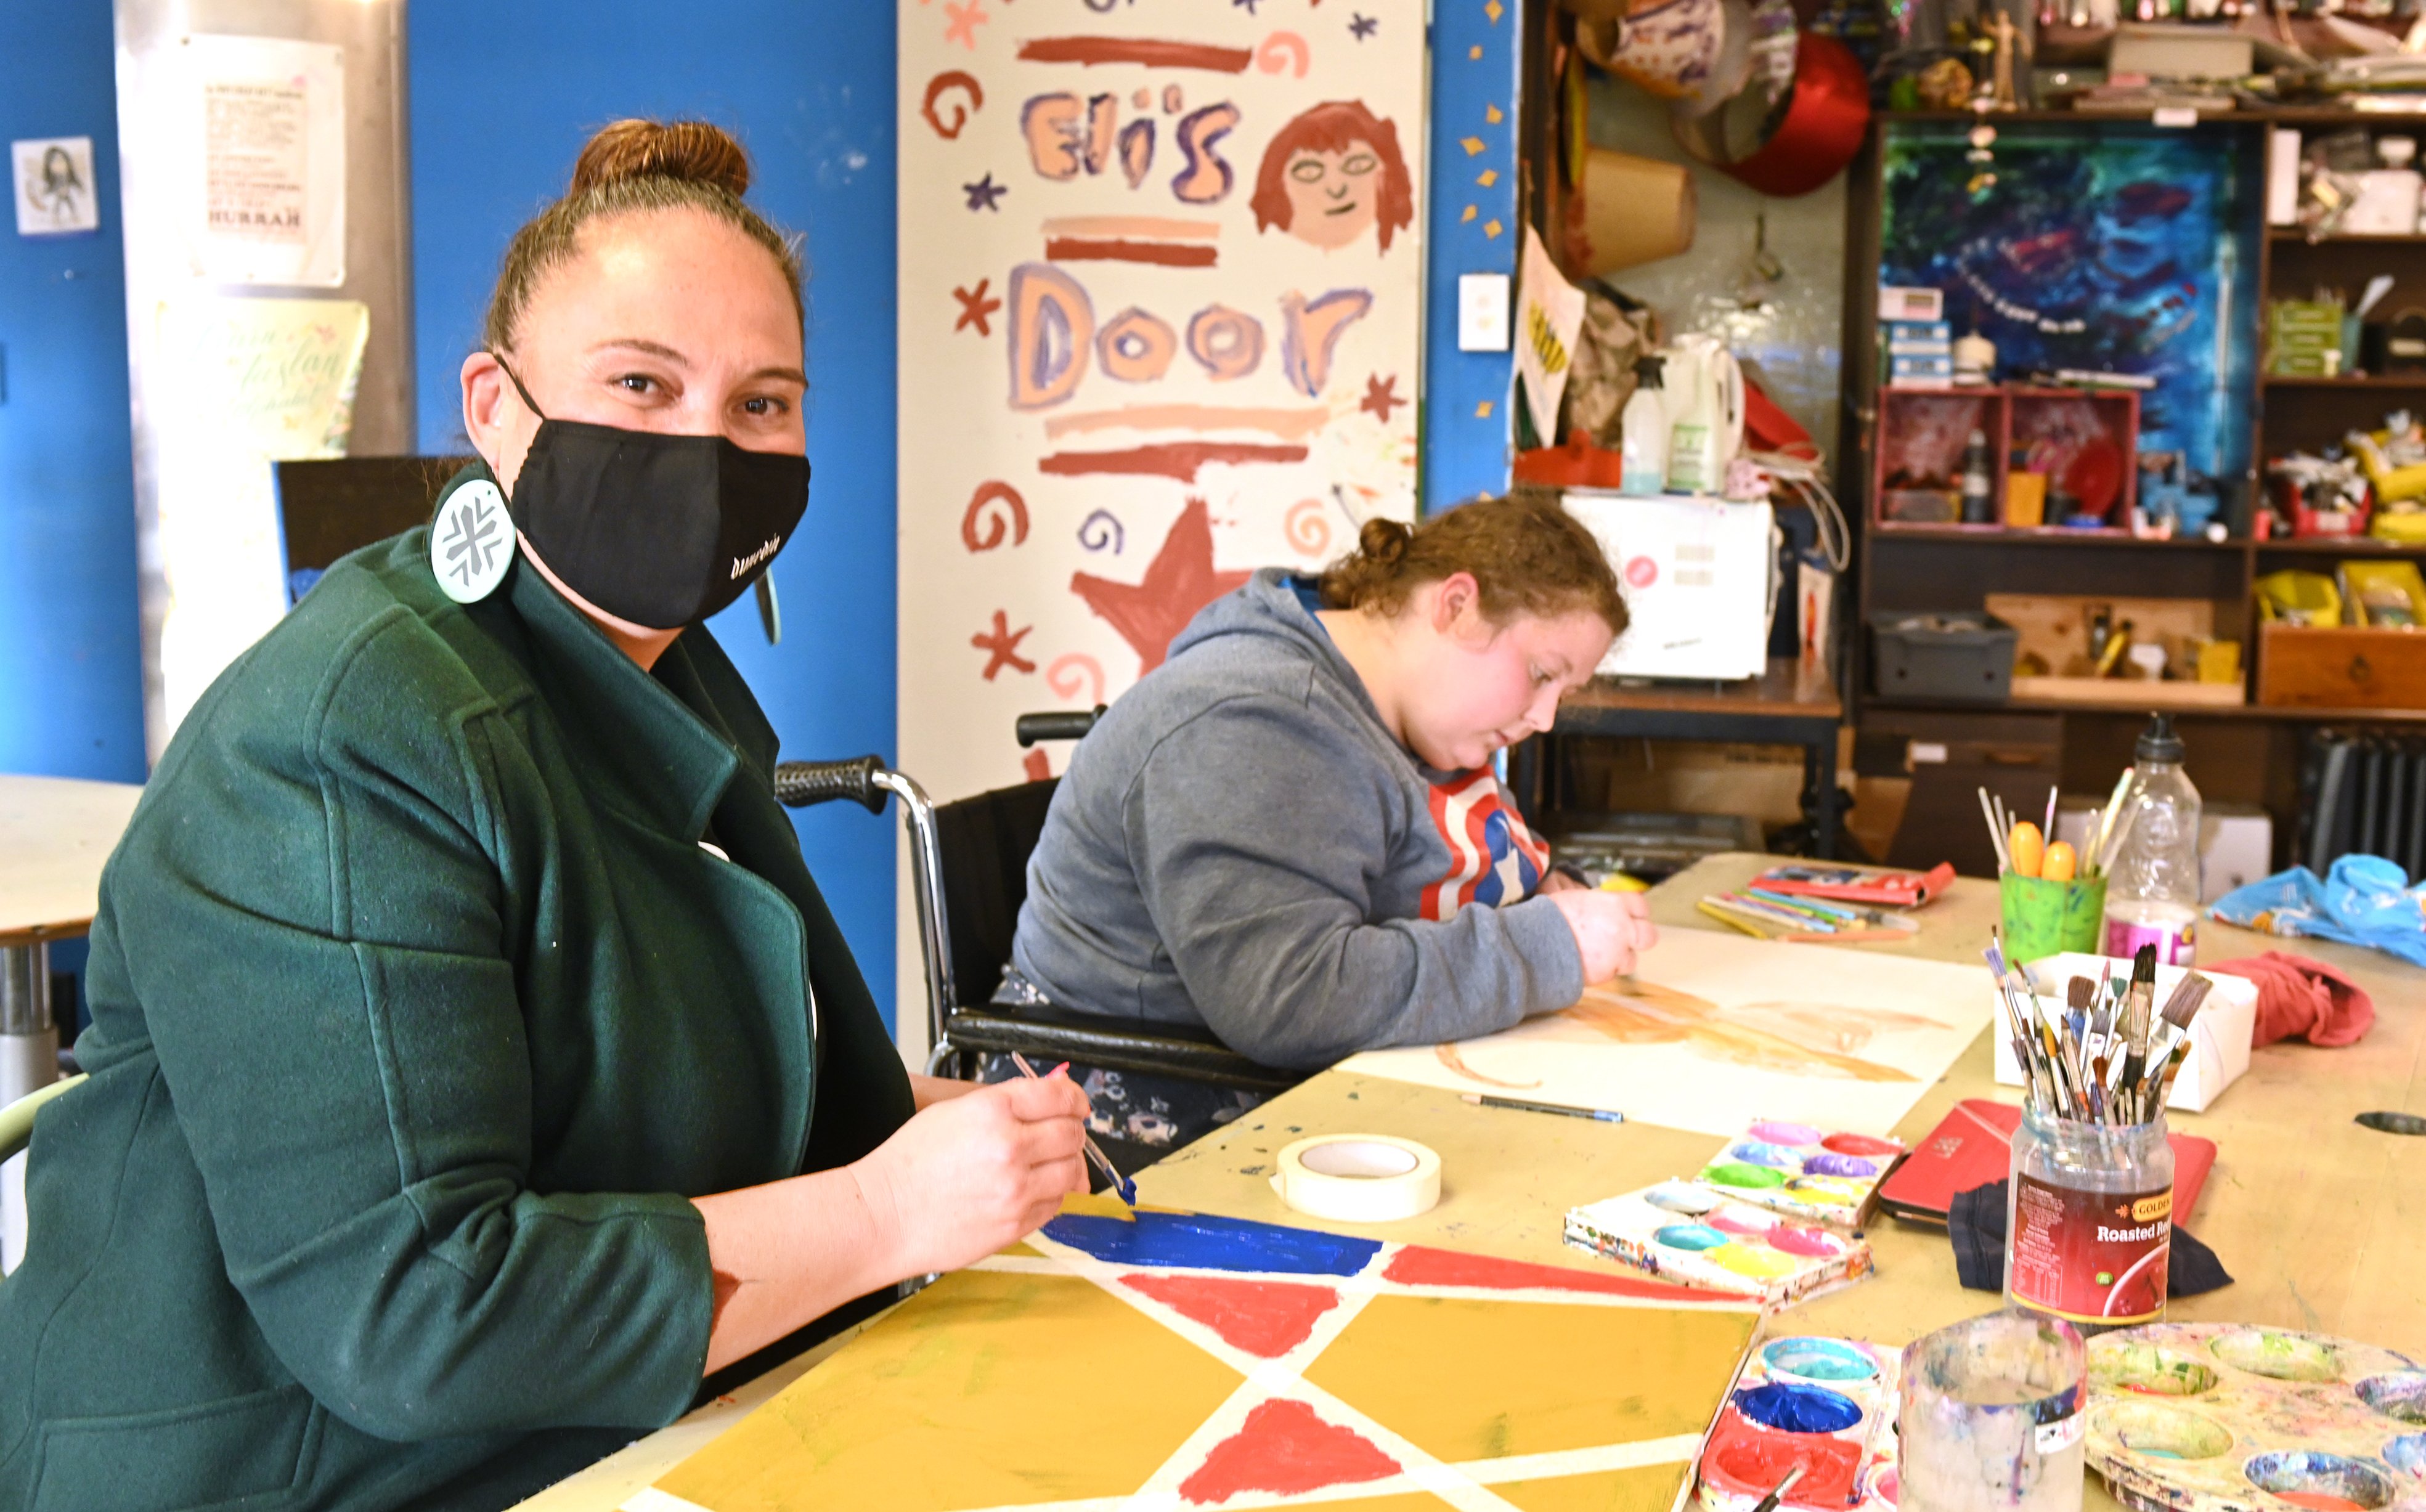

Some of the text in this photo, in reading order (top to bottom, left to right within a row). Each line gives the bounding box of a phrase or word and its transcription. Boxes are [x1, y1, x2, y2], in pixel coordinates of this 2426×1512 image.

[209, 209, 301, 227] HURRAH
[1008, 261, 1373, 411] Door
[2097, 1223, 2155, 1242] Roasted
